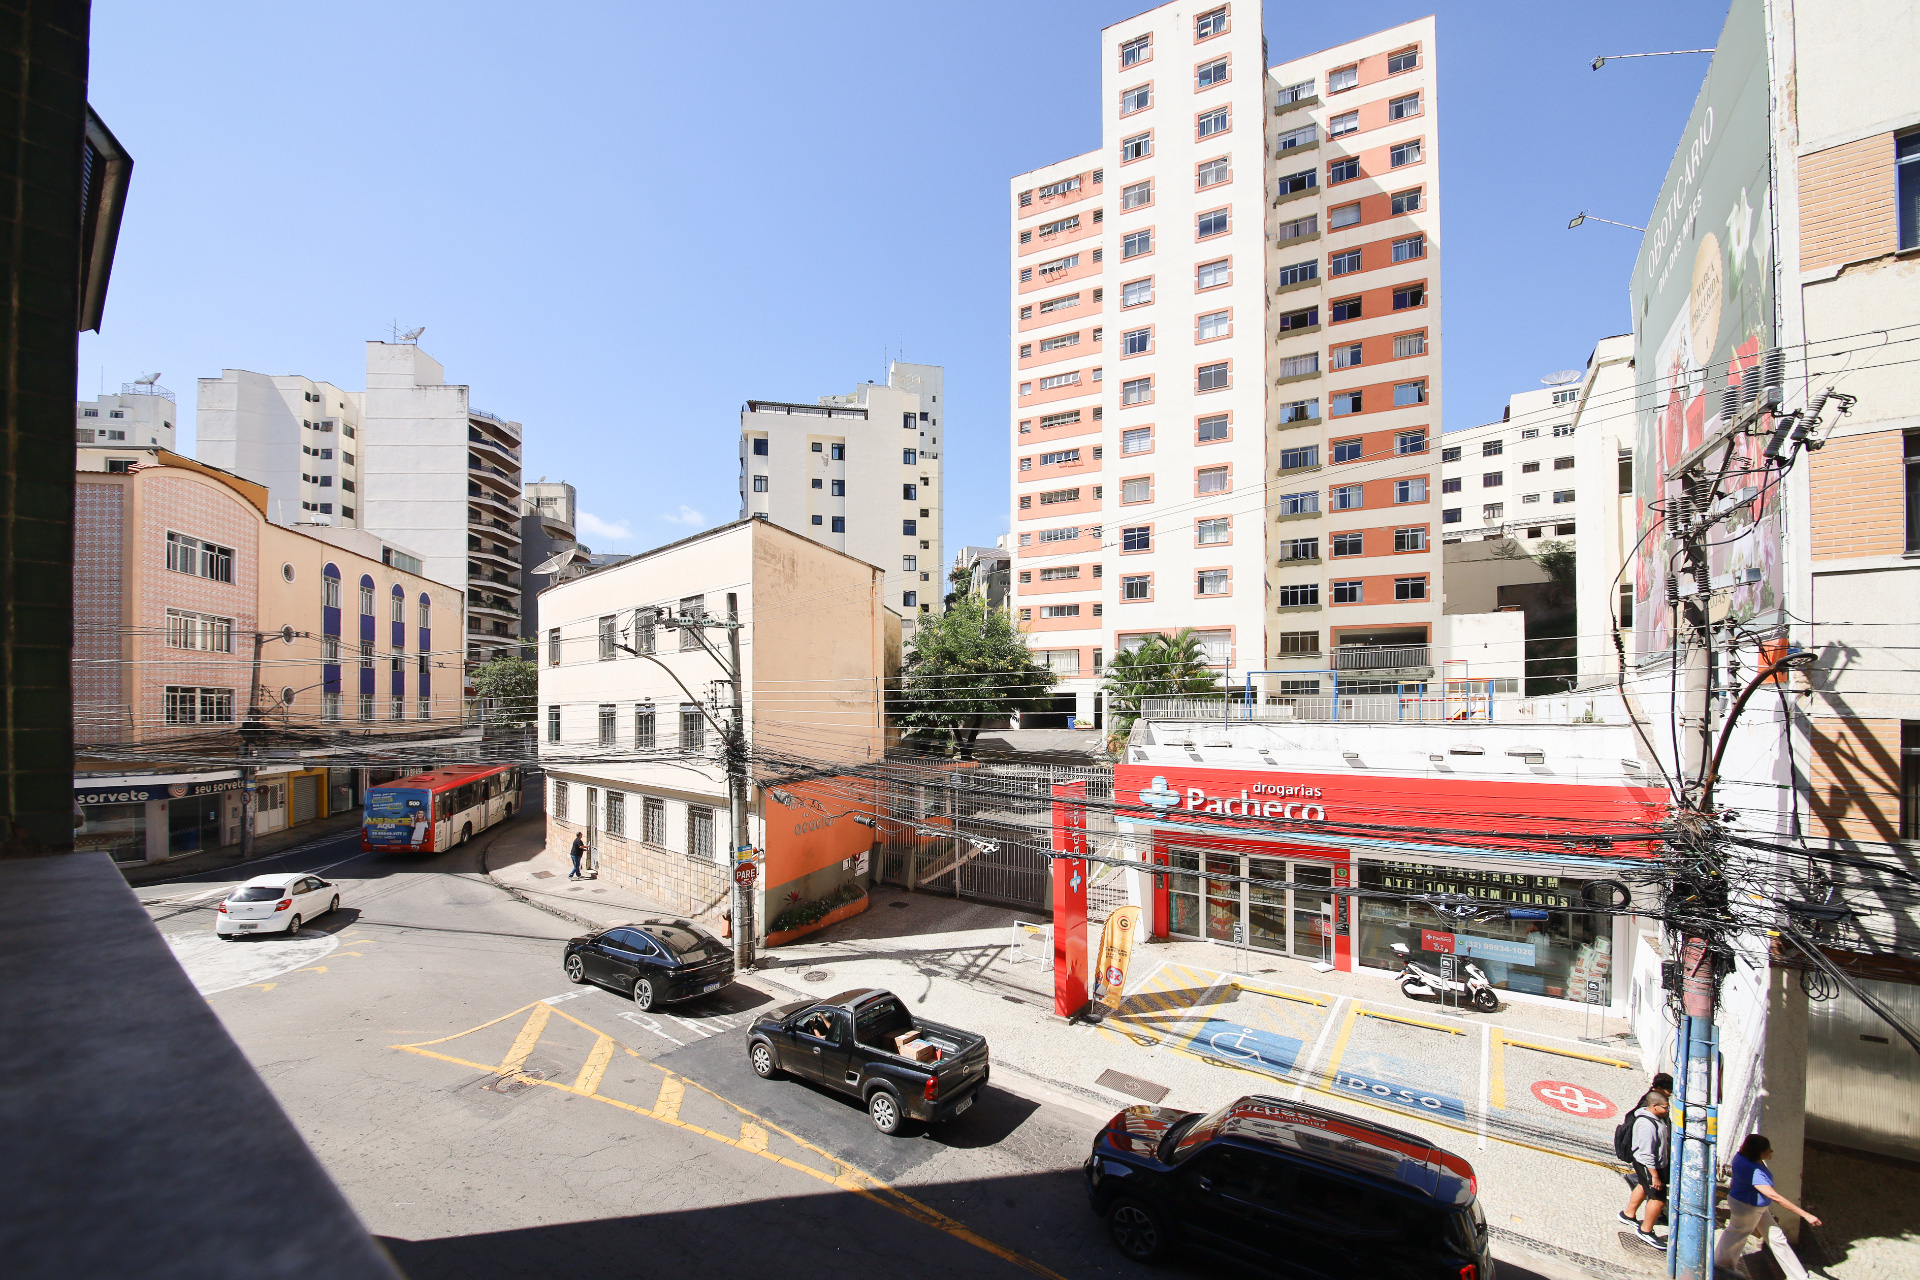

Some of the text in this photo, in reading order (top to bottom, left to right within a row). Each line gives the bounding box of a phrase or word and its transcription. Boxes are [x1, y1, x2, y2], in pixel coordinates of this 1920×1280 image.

[1658, 188, 1703, 295] DIA DAS MÃES
[1696, 261, 1715, 298] MARCA
[1691, 273, 1720, 328] PREFERIDA
[194, 779, 245, 795] seu sorvete
[1253, 782, 1322, 797] drogarias
[77, 789, 149, 804] sorvete
[1187, 788, 1325, 822] Pacheco
[736, 868, 756, 880] PARE
[1536, 876, 1558, 888] EM
[1384, 876, 1568, 908] ATÉ 10X SEM JUROS
[1120, 918, 1129, 928] G
[1465, 940, 1482, 949] (32)
[1483, 943, 1533, 956] 99934-1020
[1335, 1074, 1442, 1109] IDOSO
